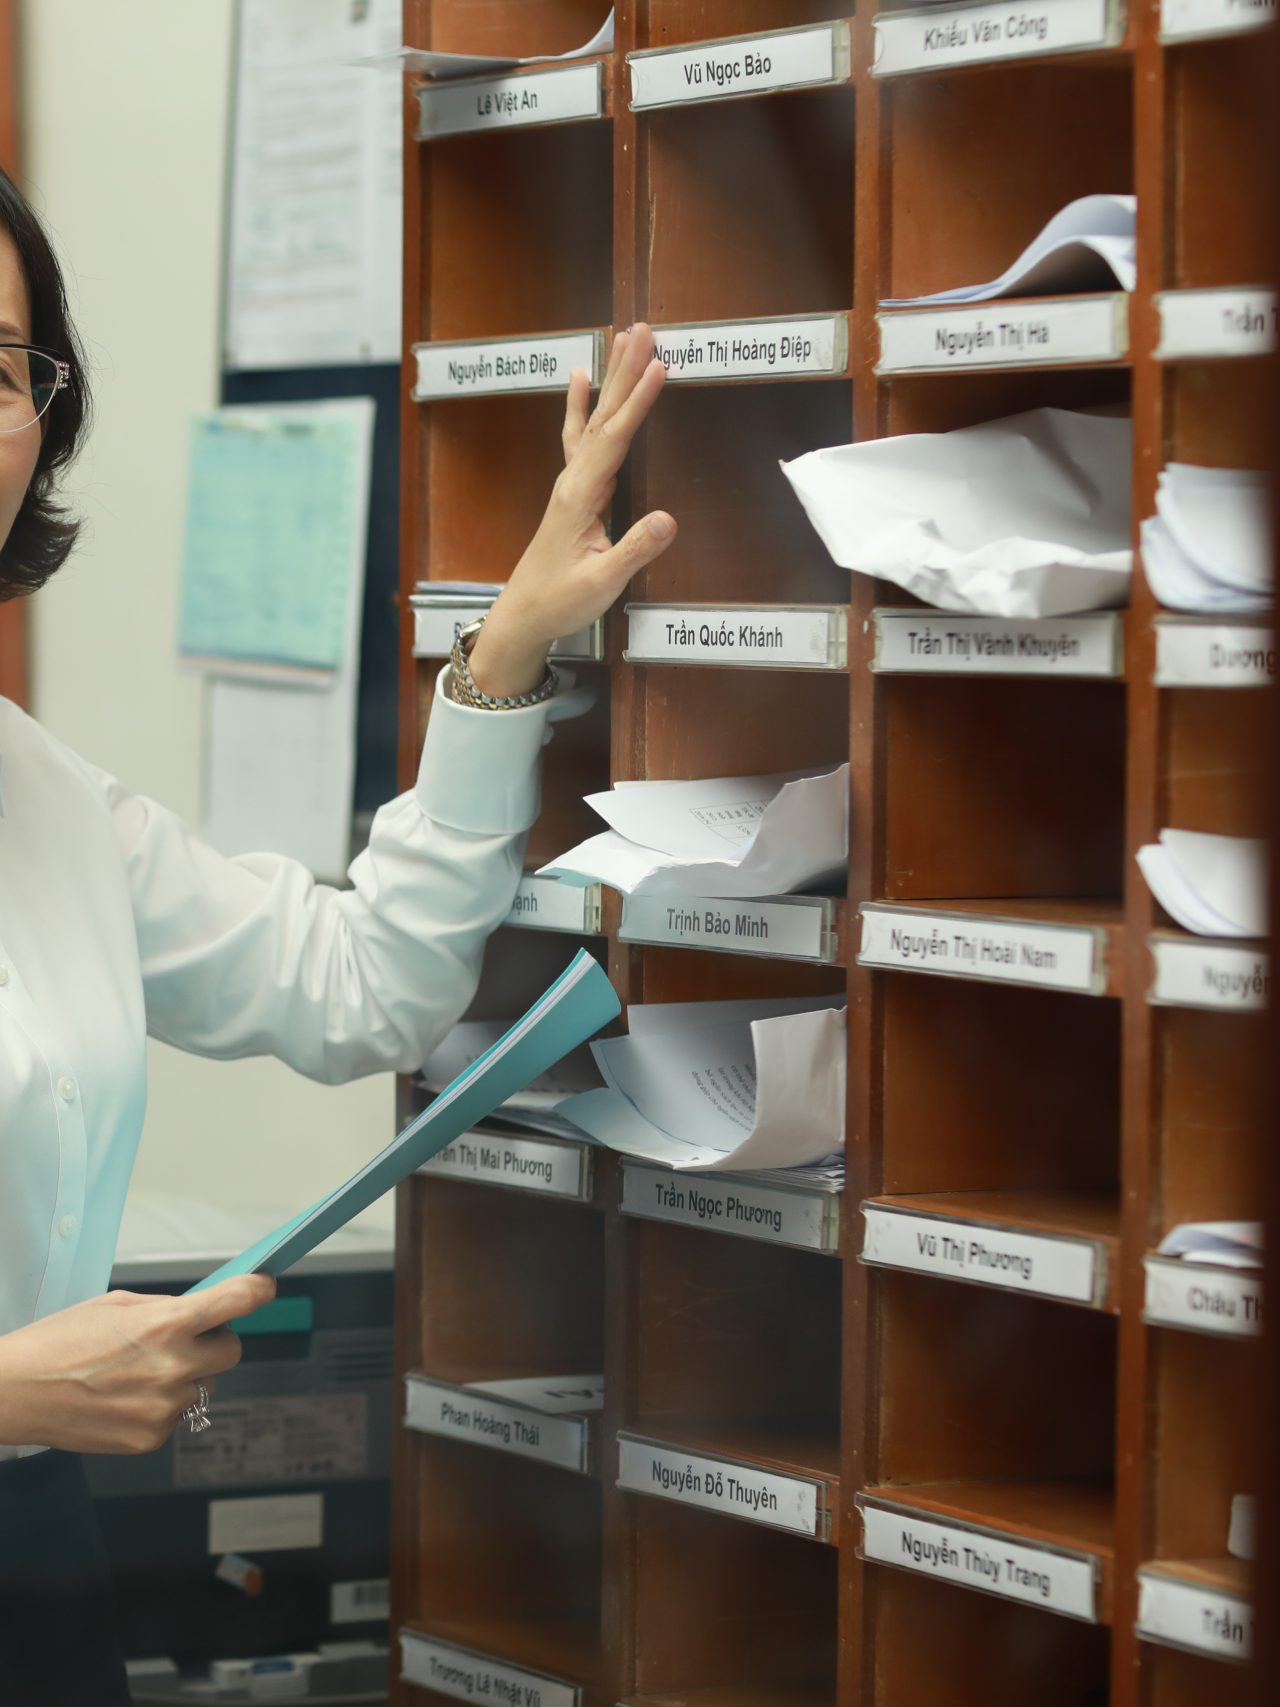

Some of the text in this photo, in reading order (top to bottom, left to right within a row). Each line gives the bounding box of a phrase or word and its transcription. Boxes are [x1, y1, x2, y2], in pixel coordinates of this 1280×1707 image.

[684, 52, 771, 86] Vũ Ngọc Bảo
[477, 89, 538, 117] Lê Việt An
[653, 335, 812, 370] Nguyễn Thị Hoàng Điệp
[936, 321, 994, 355] Nguyễn
[999, 322, 1024, 351] Thị
[448, 352, 557, 385] Nguyễn Bách Điệp
[666, 619, 783, 648] Trần Quốc Khánh
[908, 627, 942, 655] Trần
[946, 632, 971, 661] Thị
[667, 908, 769, 938] Trịnh Bảo Minh
[890, 928, 948, 960] Nguyễn
[954, 935, 977, 966] Thị
[1021, 943, 1057, 969] Nam
[459, 1144, 477, 1171] Thị
[480, 1147, 501, 1170] Mai
[504, 1151, 553, 1183] Phương
[655, 1181, 782, 1233] Trần Ngọc Phương
[917, 1232, 1032, 1280] Vũ Thị Phương
[441, 1402, 470, 1428] Phan
[513, 1420, 540, 1446] Thái
[652, 1460, 777, 1511] Nguyễn Đỗ Thuyên
[902, 1531, 959, 1567] Nguyễn
[1005, 1558, 1051, 1598] Trang
